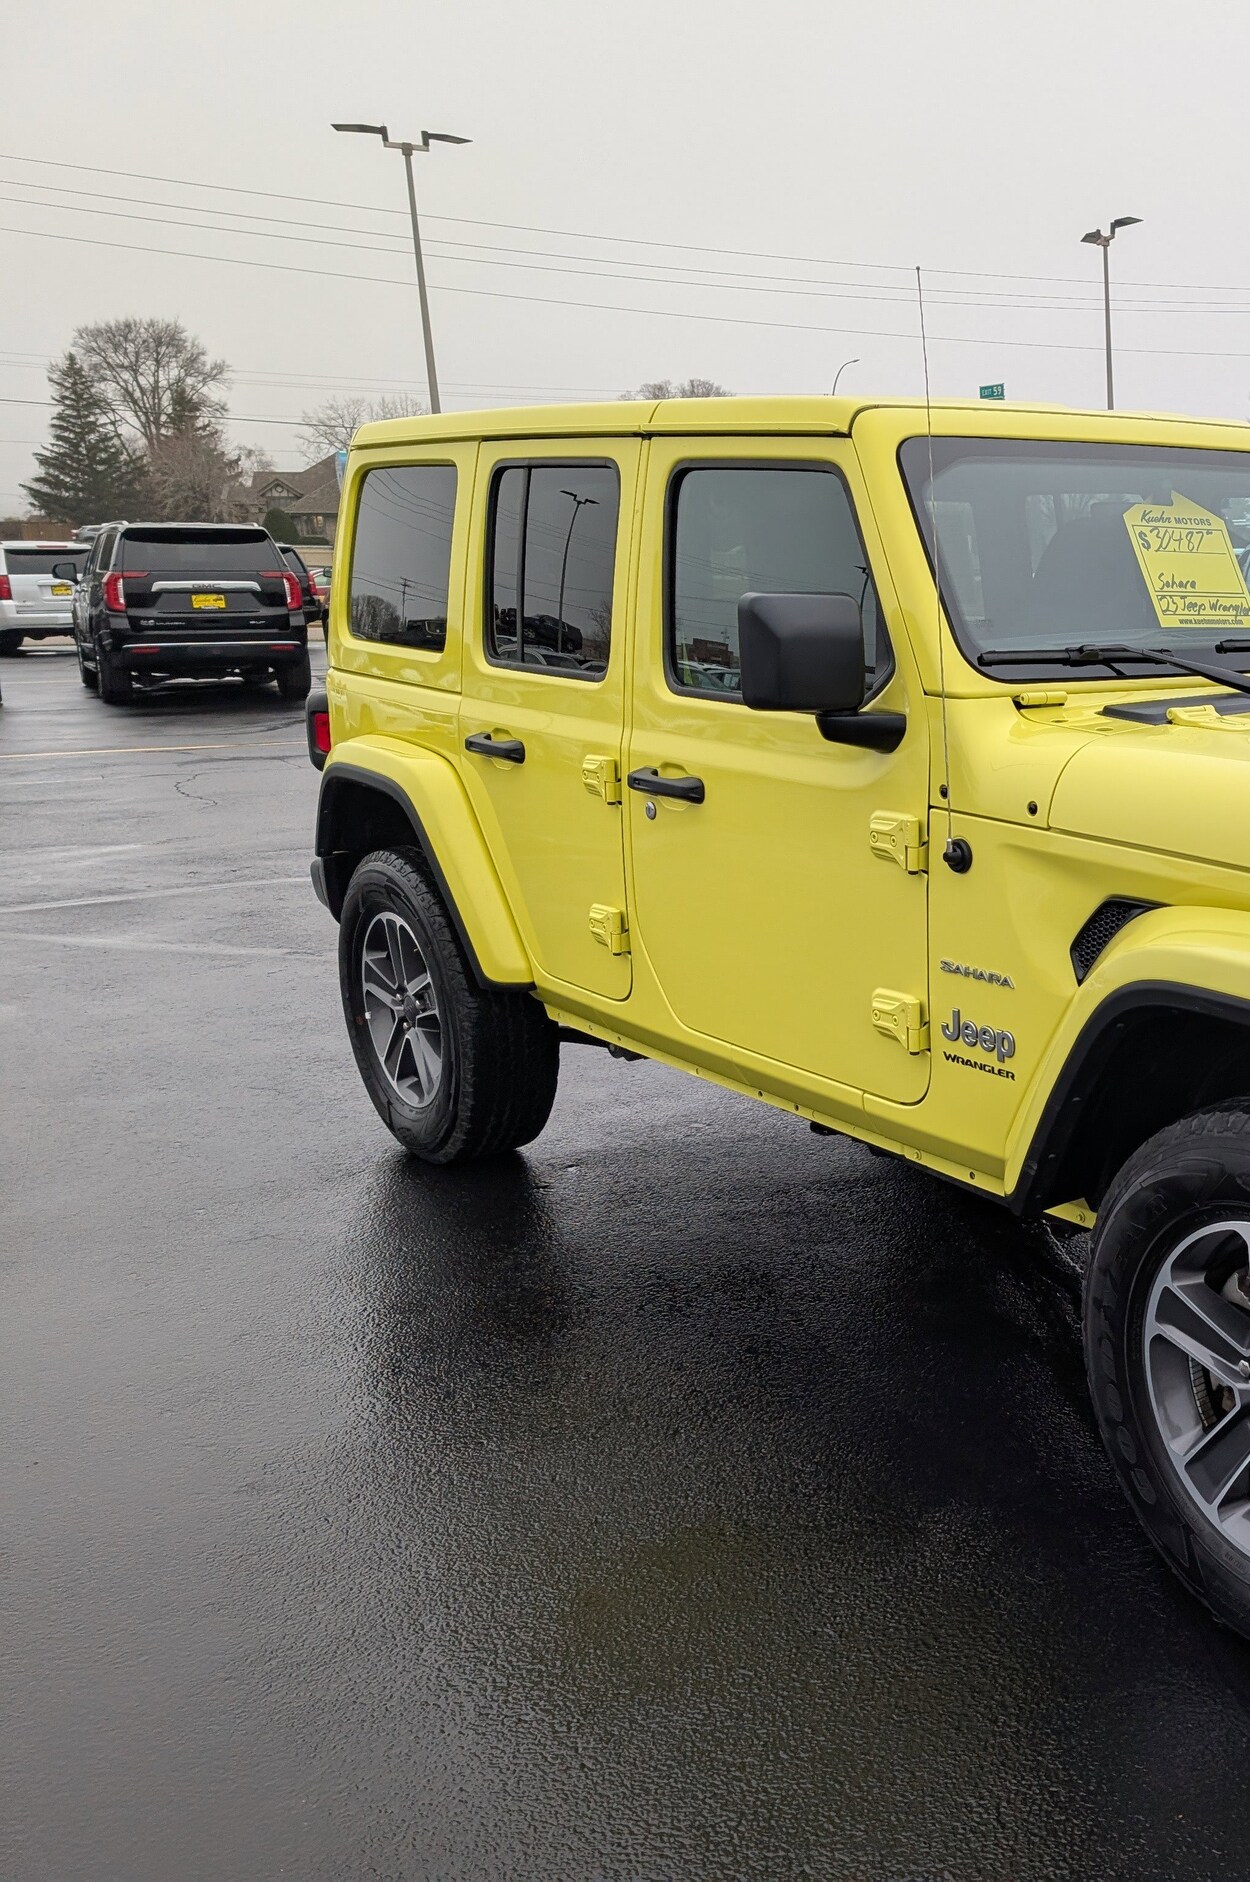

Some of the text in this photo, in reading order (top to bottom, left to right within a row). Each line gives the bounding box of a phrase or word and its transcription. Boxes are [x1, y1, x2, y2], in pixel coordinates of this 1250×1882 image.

[993, 386, 1002, 396] 59
[1140, 510, 1212, 526] Kuehn MOTORS
[1180, 596, 1207, 615] Jeep
[940, 959, 1015, 989] SAHARA
[940, 1007, 1016, 1064] Jeep
[943, 1050, 1016, 1081] WRANGLER
